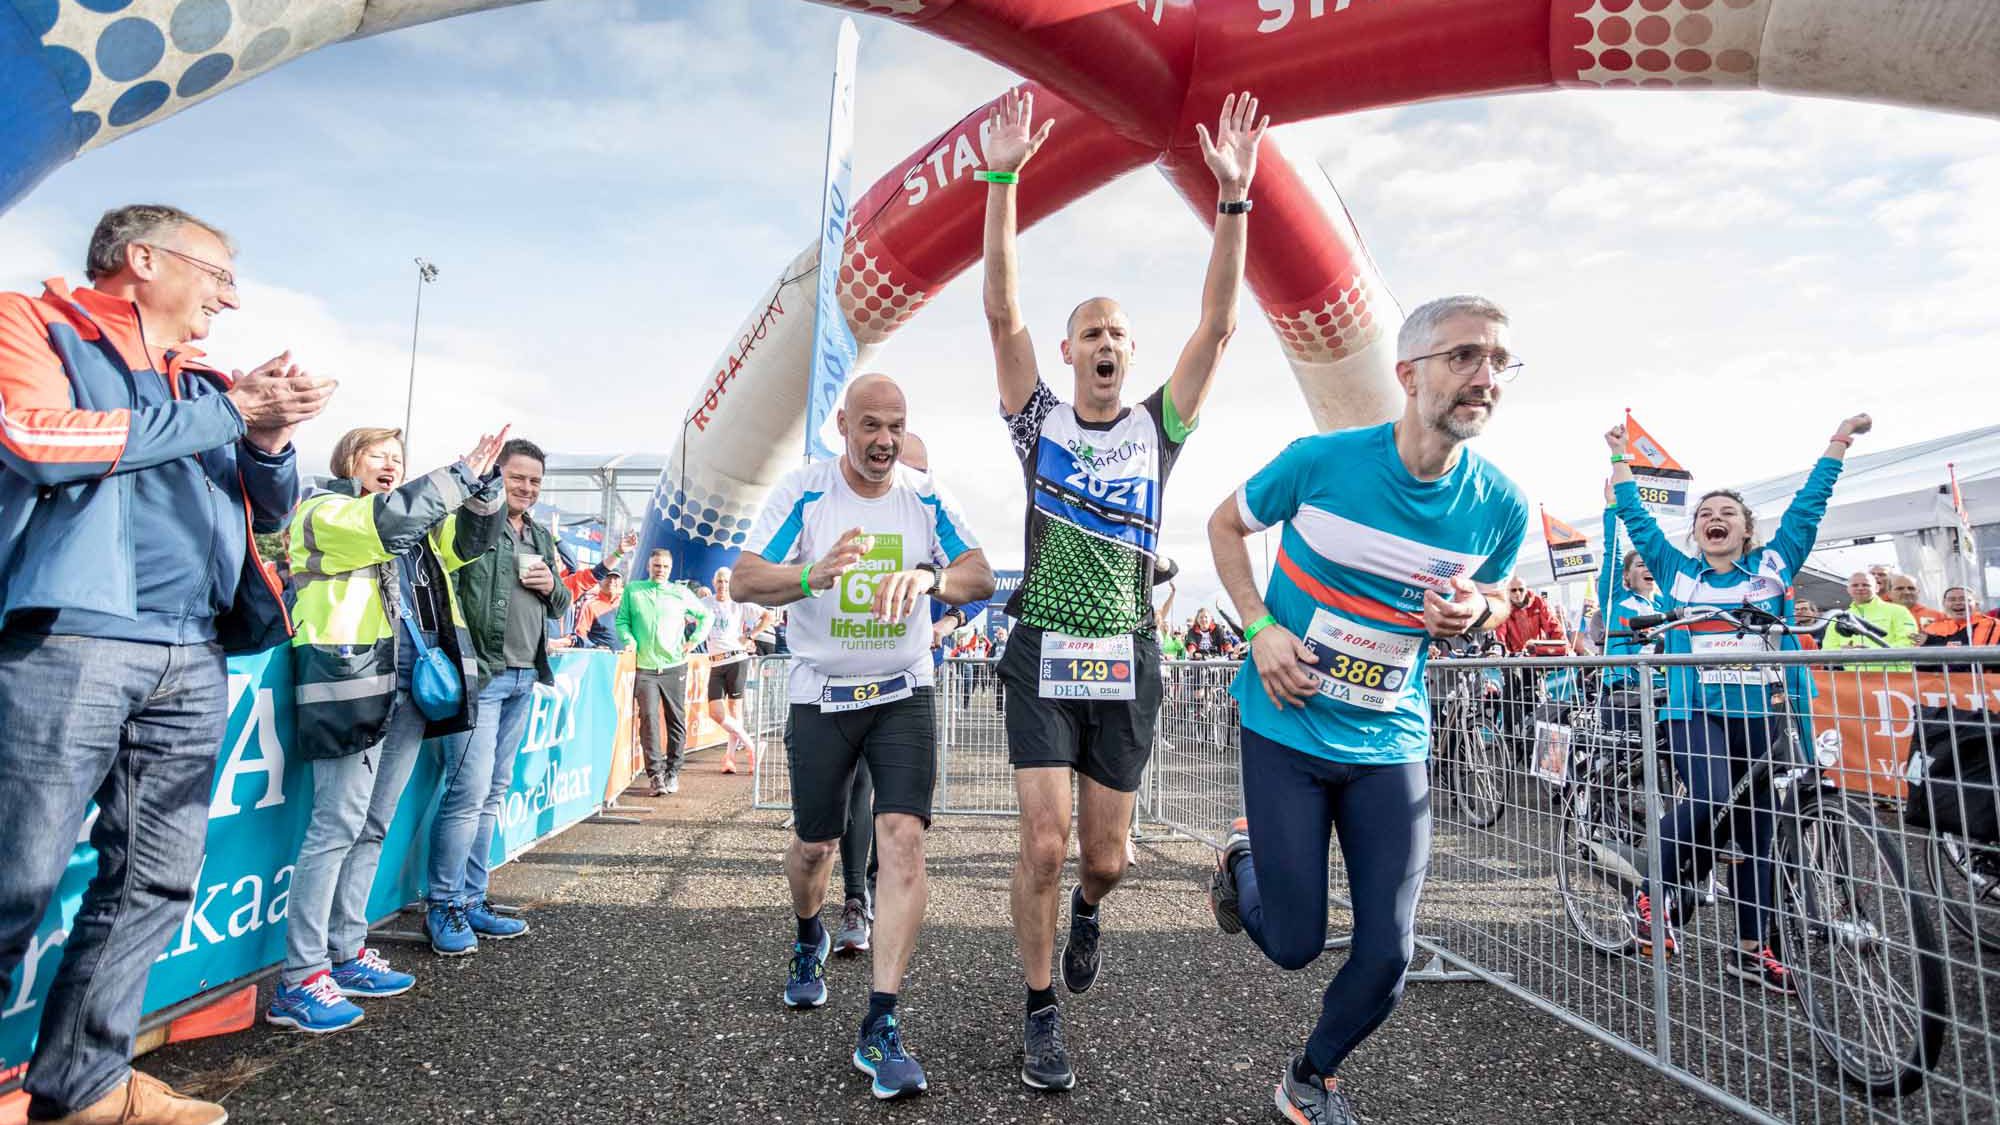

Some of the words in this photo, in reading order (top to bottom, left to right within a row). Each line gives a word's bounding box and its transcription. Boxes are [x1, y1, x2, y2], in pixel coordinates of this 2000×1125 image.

[1064, 462, 1148, 509] 2021
[1639, 487, 1670, 504] 386
[853, 560, 897, 571] eam
[993, 576, 1024, 591] INIS
[830, 617, 907, 639] lifeline
[841, 640, 897, 650] runners
[1043, 659, 1052, 679] 2021
[1068, 659, 1109, 681] 129
[1330, 655, 1385, 688] 386
[853, 683, 881, 701] 62
